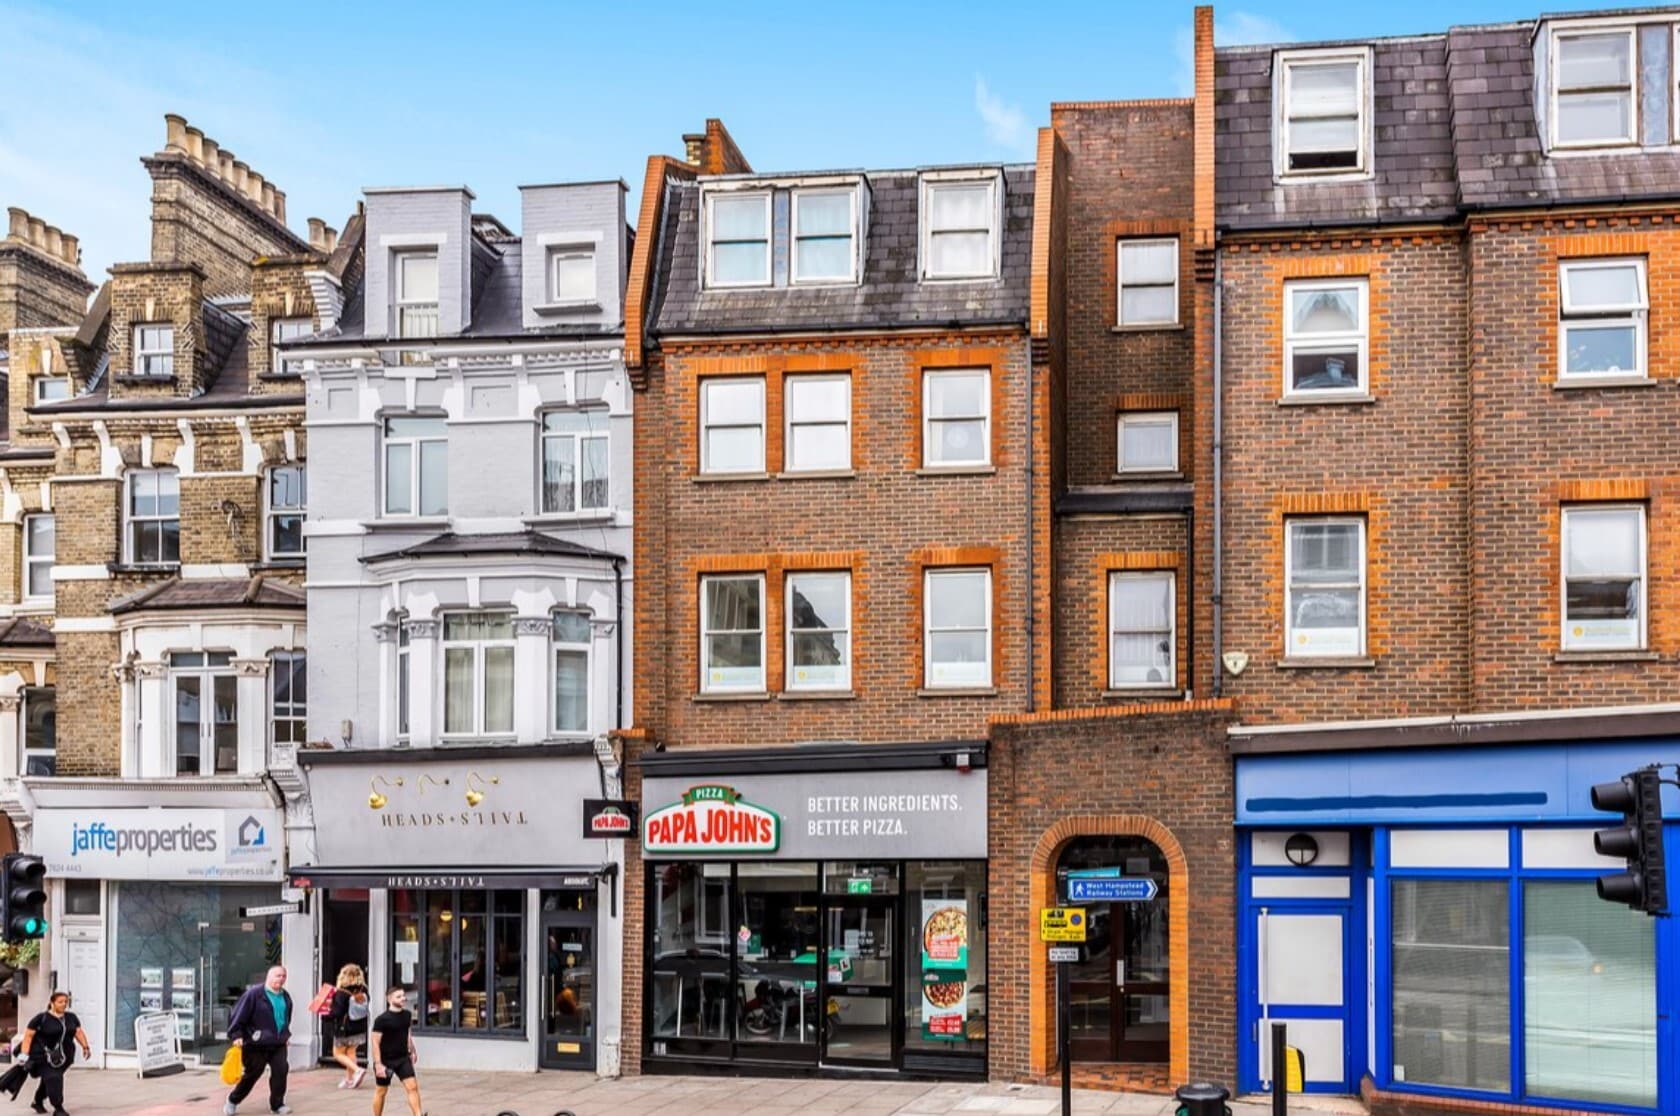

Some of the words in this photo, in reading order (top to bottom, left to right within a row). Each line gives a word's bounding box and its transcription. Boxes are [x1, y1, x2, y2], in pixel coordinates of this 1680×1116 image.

[695, 787, 723, 799] PIZZA
[808, 797, 859, 813] BETTER
[863, 794, 963, 812] INGREDIENTS.
[381, 813, 445, 827] HEADS
[648, 810, 698, 844] PAPA
[701, 809, 772, 844] JOHN'S
[808, 819, 859, 836] BETTER
[863, 818, 908, 835] PIZZA.
[71, 822, 217, 857] jaffeproperties
[387, 876, 430, 887] HEADS
[1105, 882, 1144, 890] Hampstead
[1086, 889, 1113, 897] Railway
